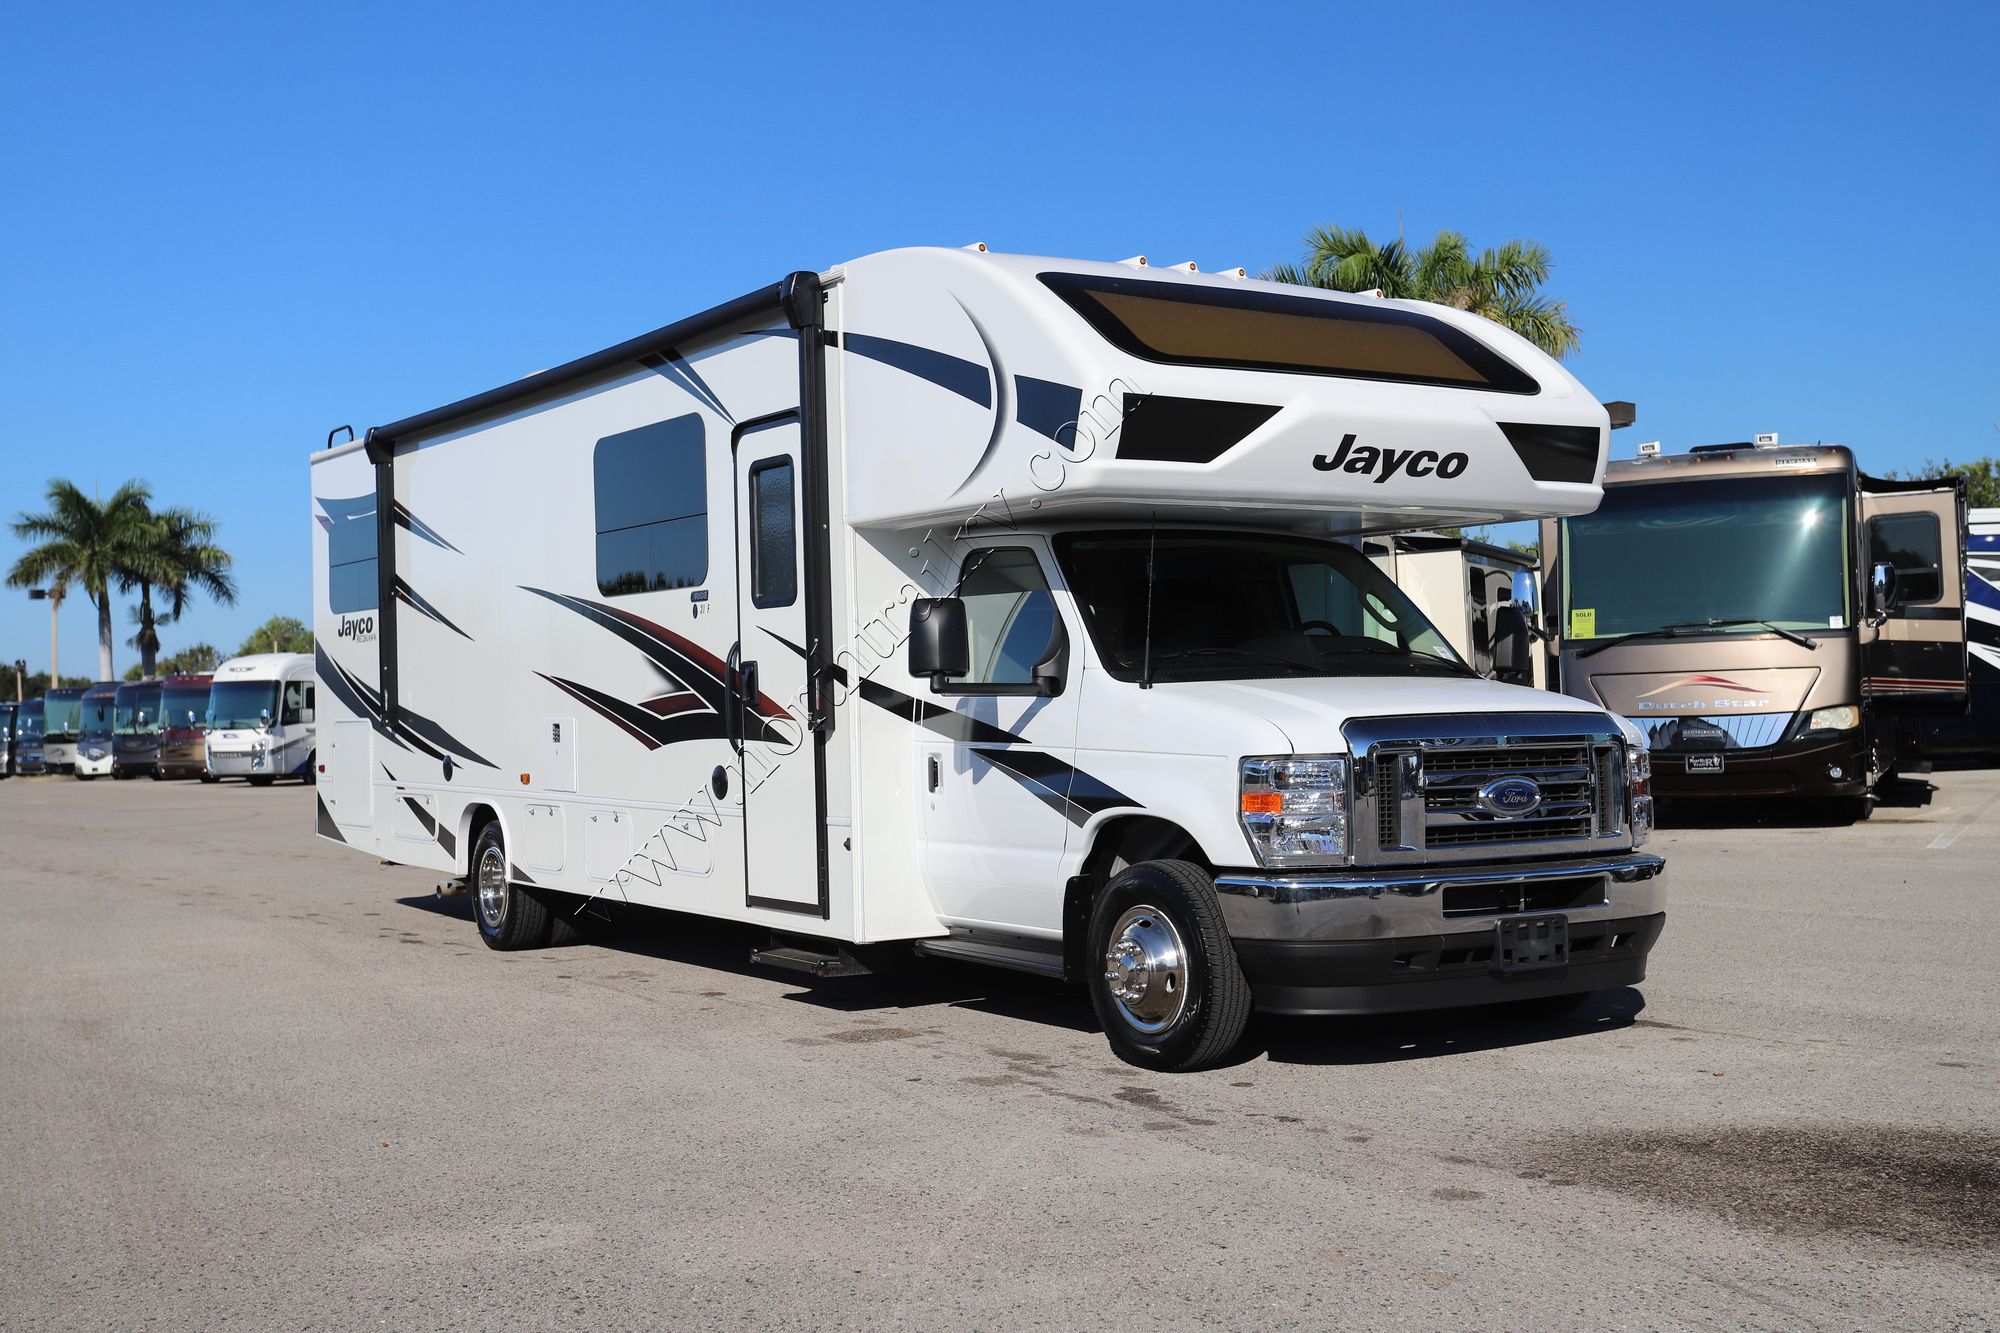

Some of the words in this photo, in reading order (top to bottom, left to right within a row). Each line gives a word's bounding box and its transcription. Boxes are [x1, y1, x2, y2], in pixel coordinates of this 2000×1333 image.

[1312, 433, 1469, 484] Jayco
[337, 615, 373, 641] Jayco
[1638, 701, 1709, 710] Dutch
[1714, 699, 1769, 708] Star
[1503, 788, 1529, 803] Ford
